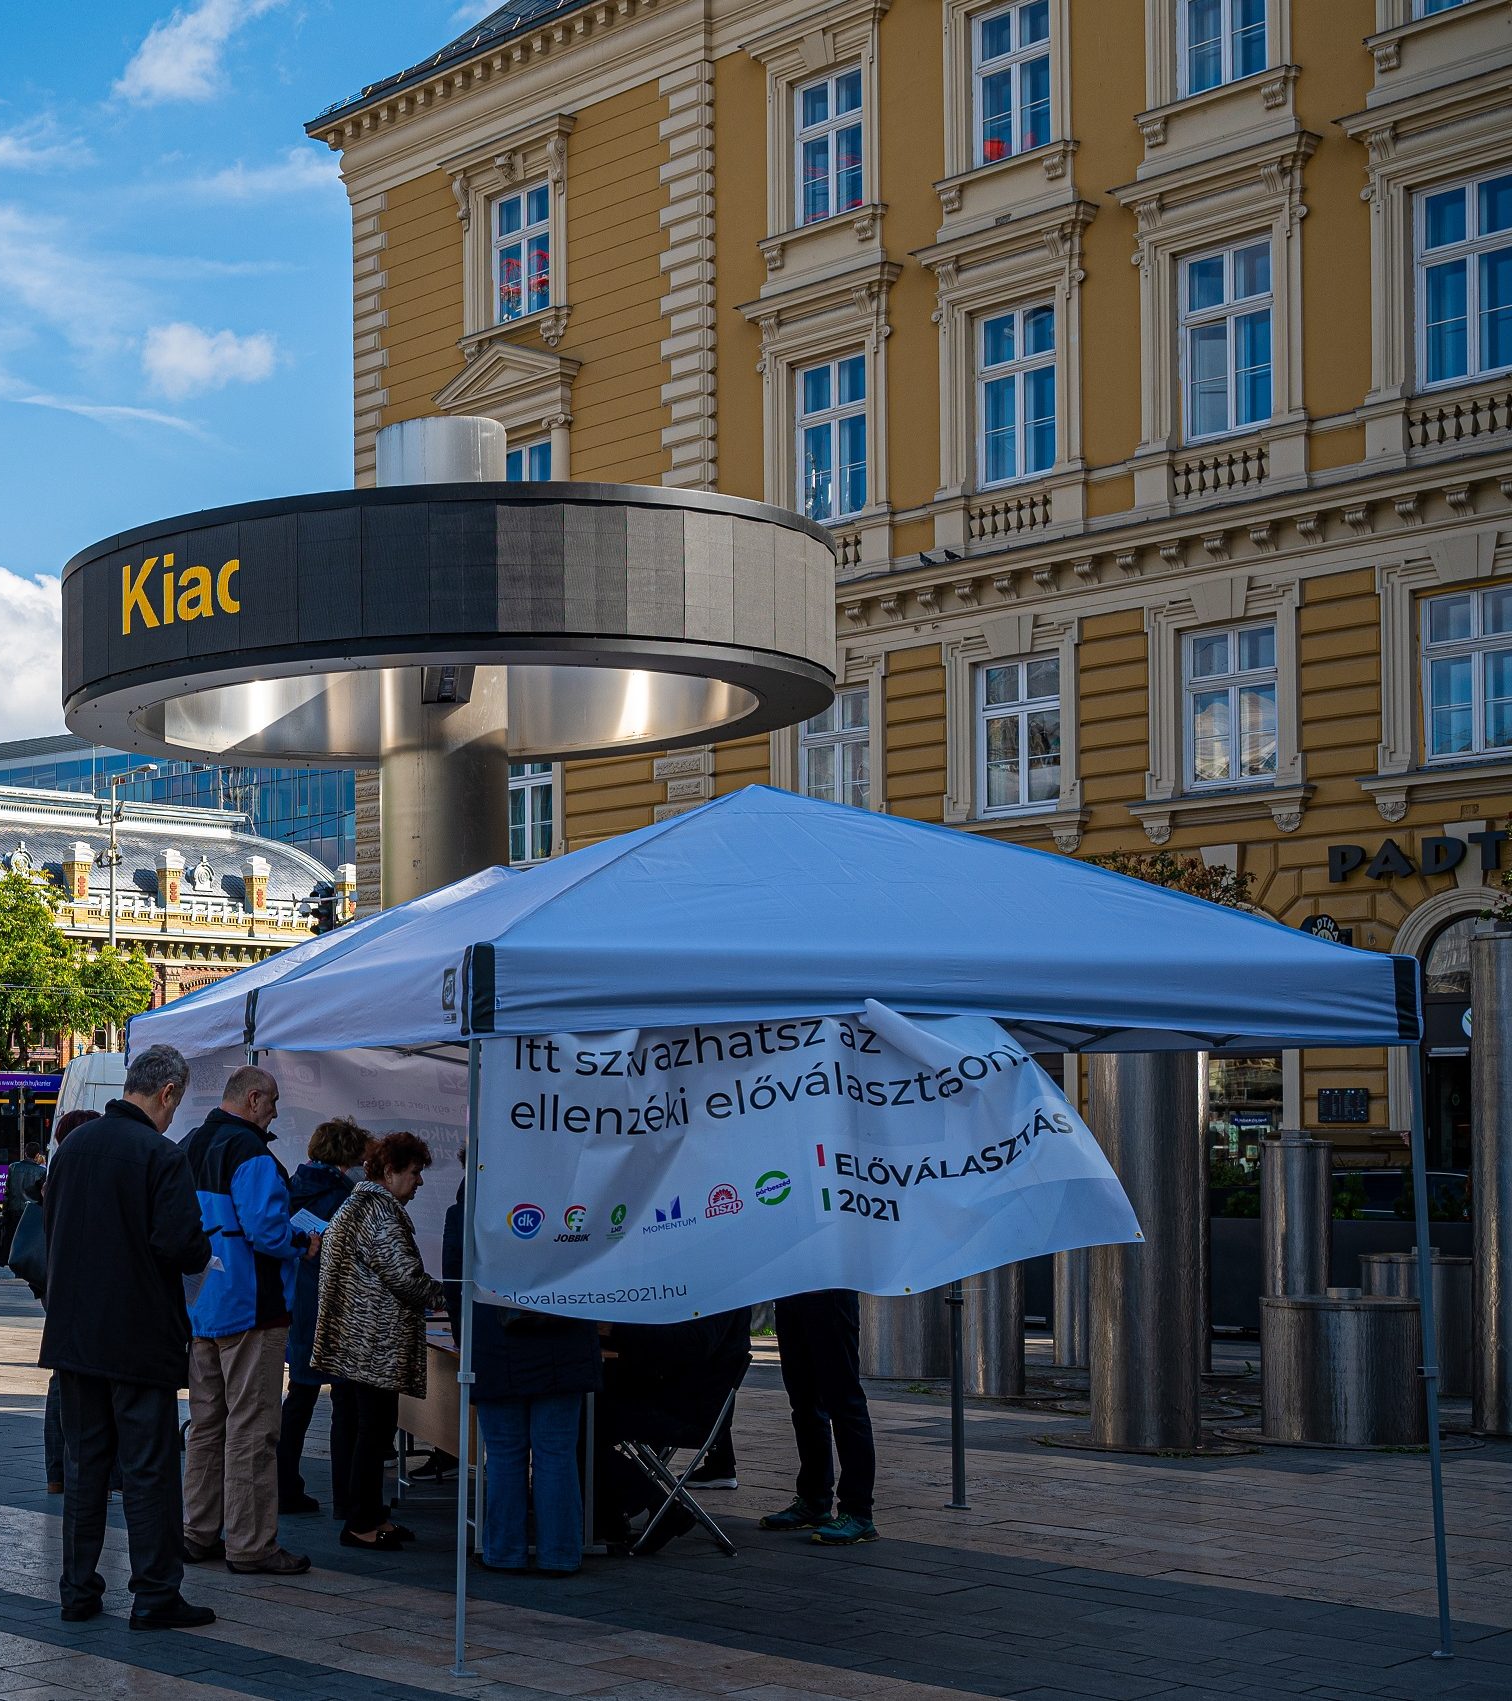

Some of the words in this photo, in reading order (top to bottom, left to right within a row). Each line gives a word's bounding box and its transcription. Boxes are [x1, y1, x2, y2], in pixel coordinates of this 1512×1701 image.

[1328, 831, 1508, 883] PADT
[514, 1035, 562, 1074] Itt
[575, 1019, 826, 1078] szvazhatsz
[839, 1021, 882, 1054] az
[510, 1086, 689, 1135] ellenzéki
[835, 1108, 1074, 1188] ELŐVÁLASZTÁS
[755, 1178, 791, 1198] párbeszéd
[705, 1199, 744, 1219] mszp
[837, 1189, 901, 1222] 2021
[517, 1212, 534, 1228] dk
[642, 1217, 697, 1235] MOMENTUM
[553, 1233, 591, 1243] JOBBIK
